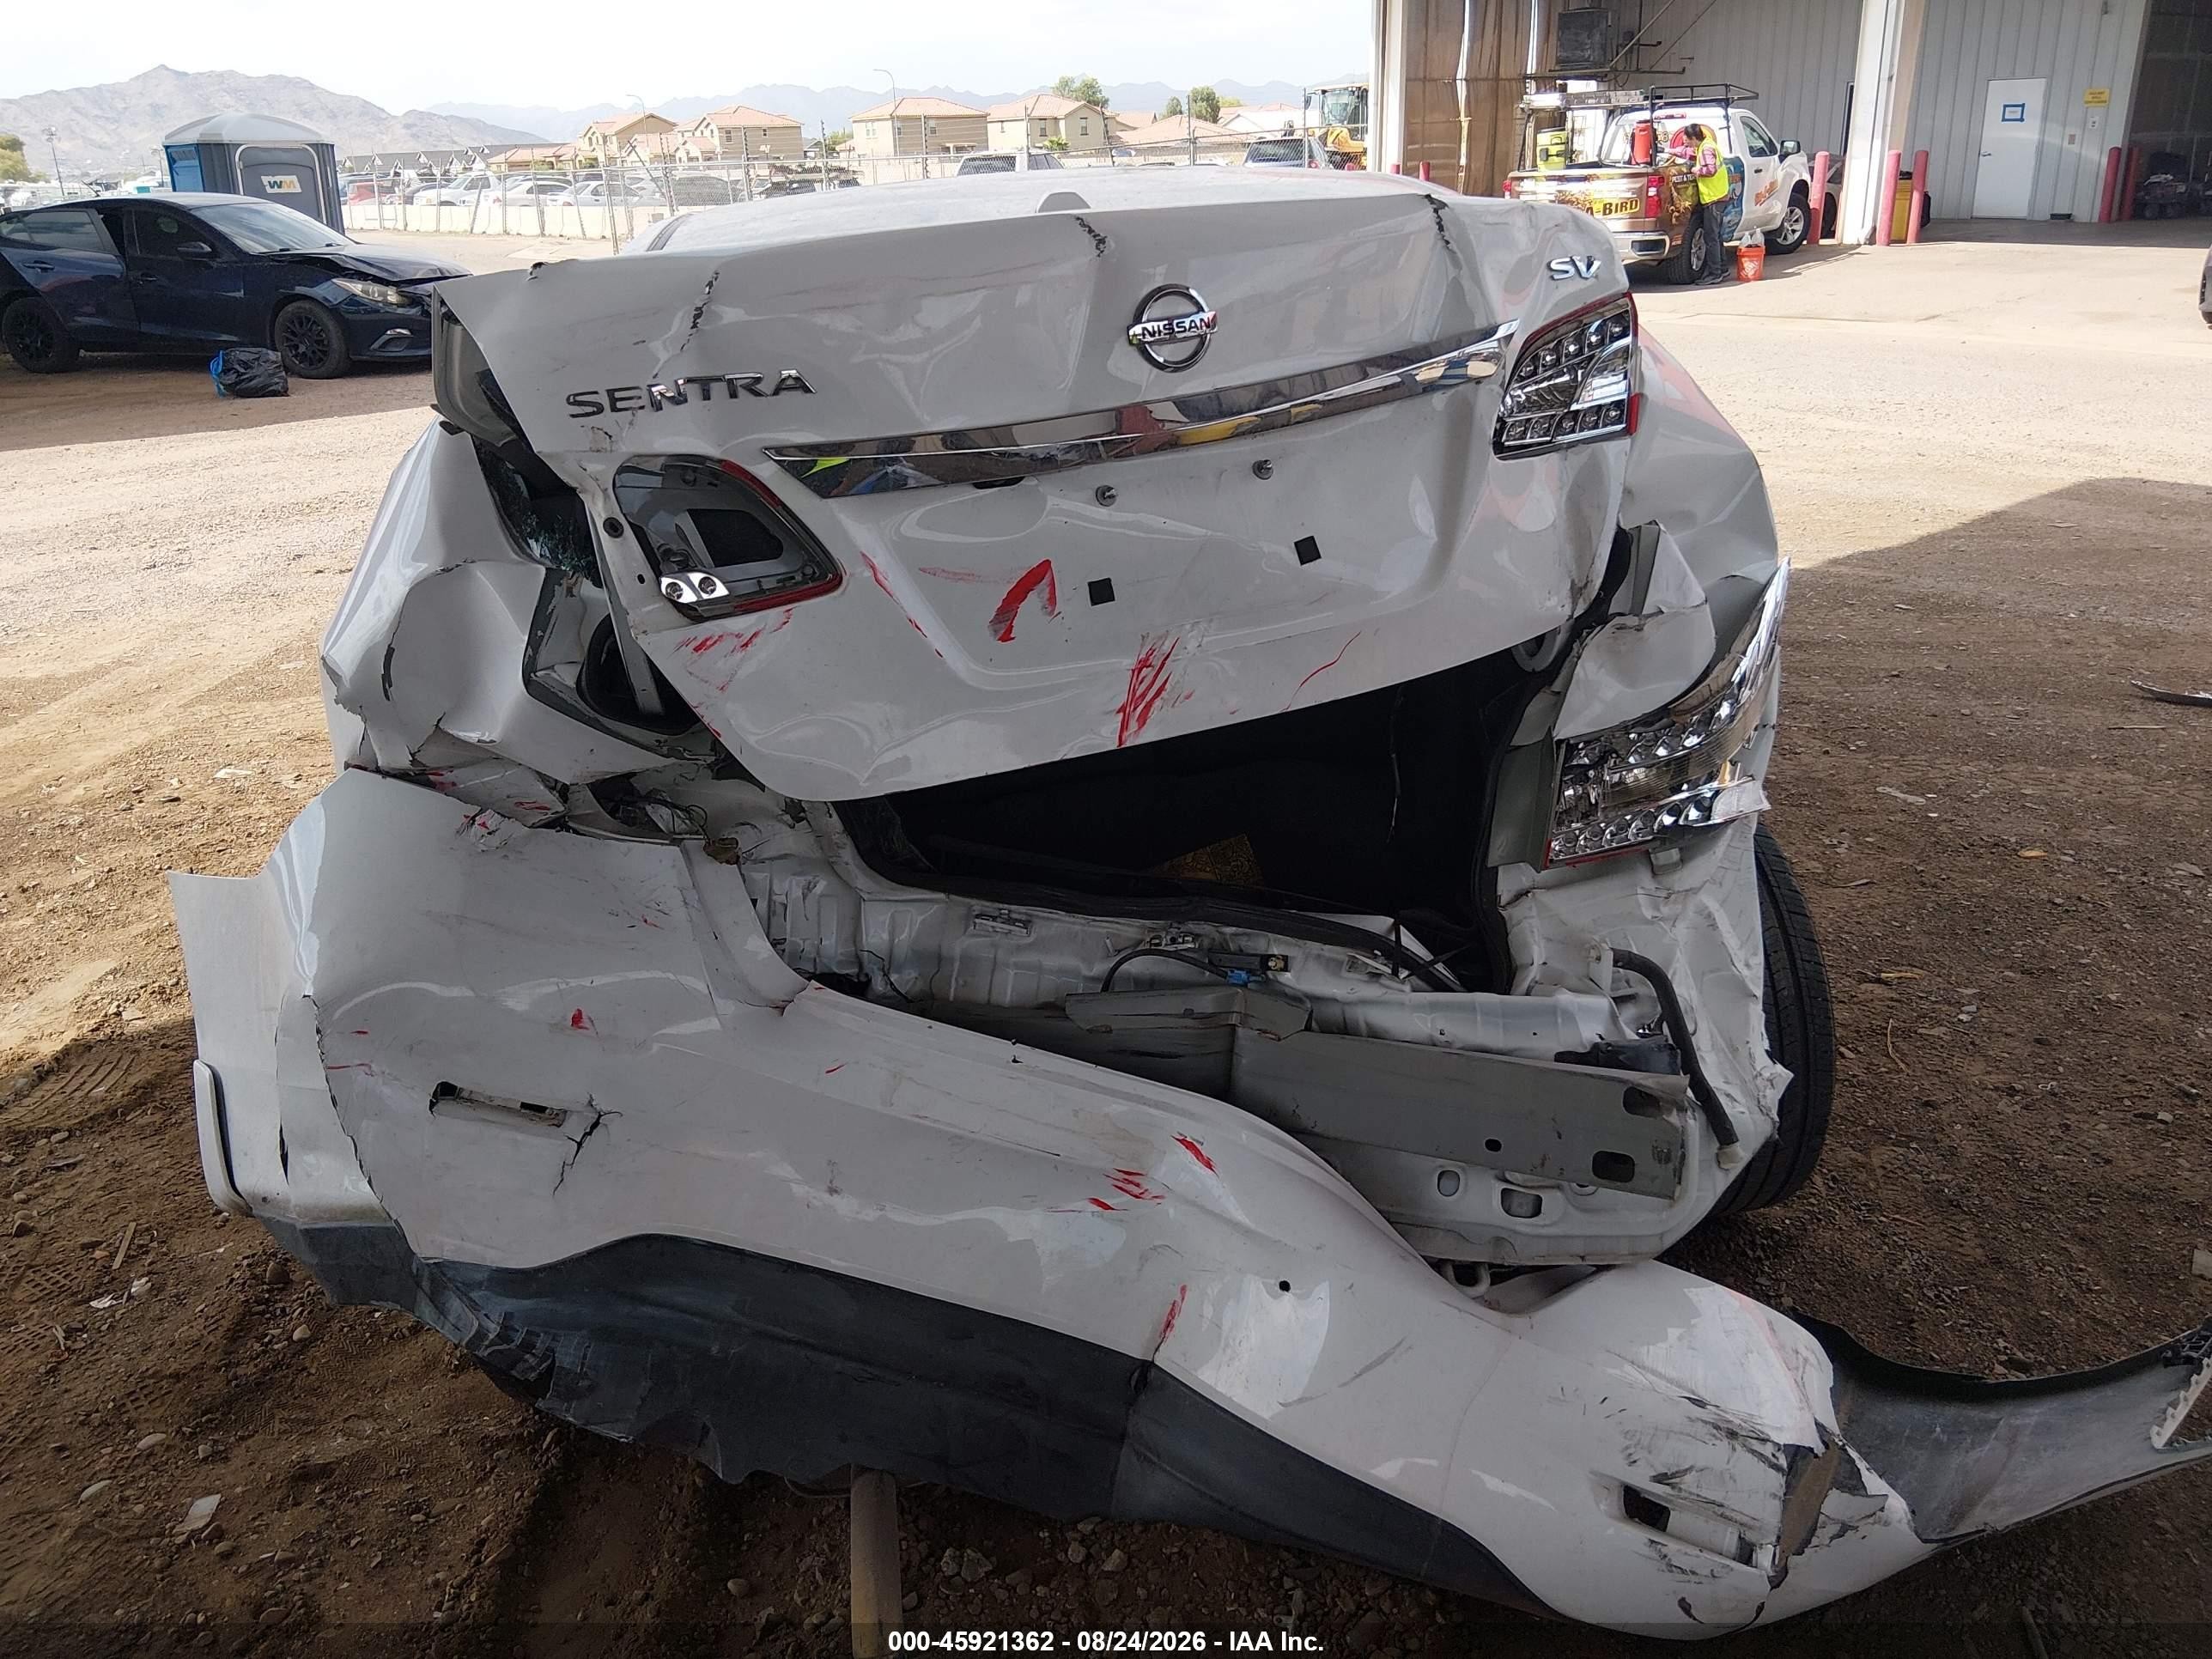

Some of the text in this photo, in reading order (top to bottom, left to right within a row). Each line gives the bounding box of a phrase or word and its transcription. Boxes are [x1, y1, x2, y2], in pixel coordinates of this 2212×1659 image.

[268, 180, 296, 189] WM
[1547, 256, 1601, 281] SV
[1141, 316, 1211, 339] NISSAN
[566, 369, 817, 418] SENTRA
